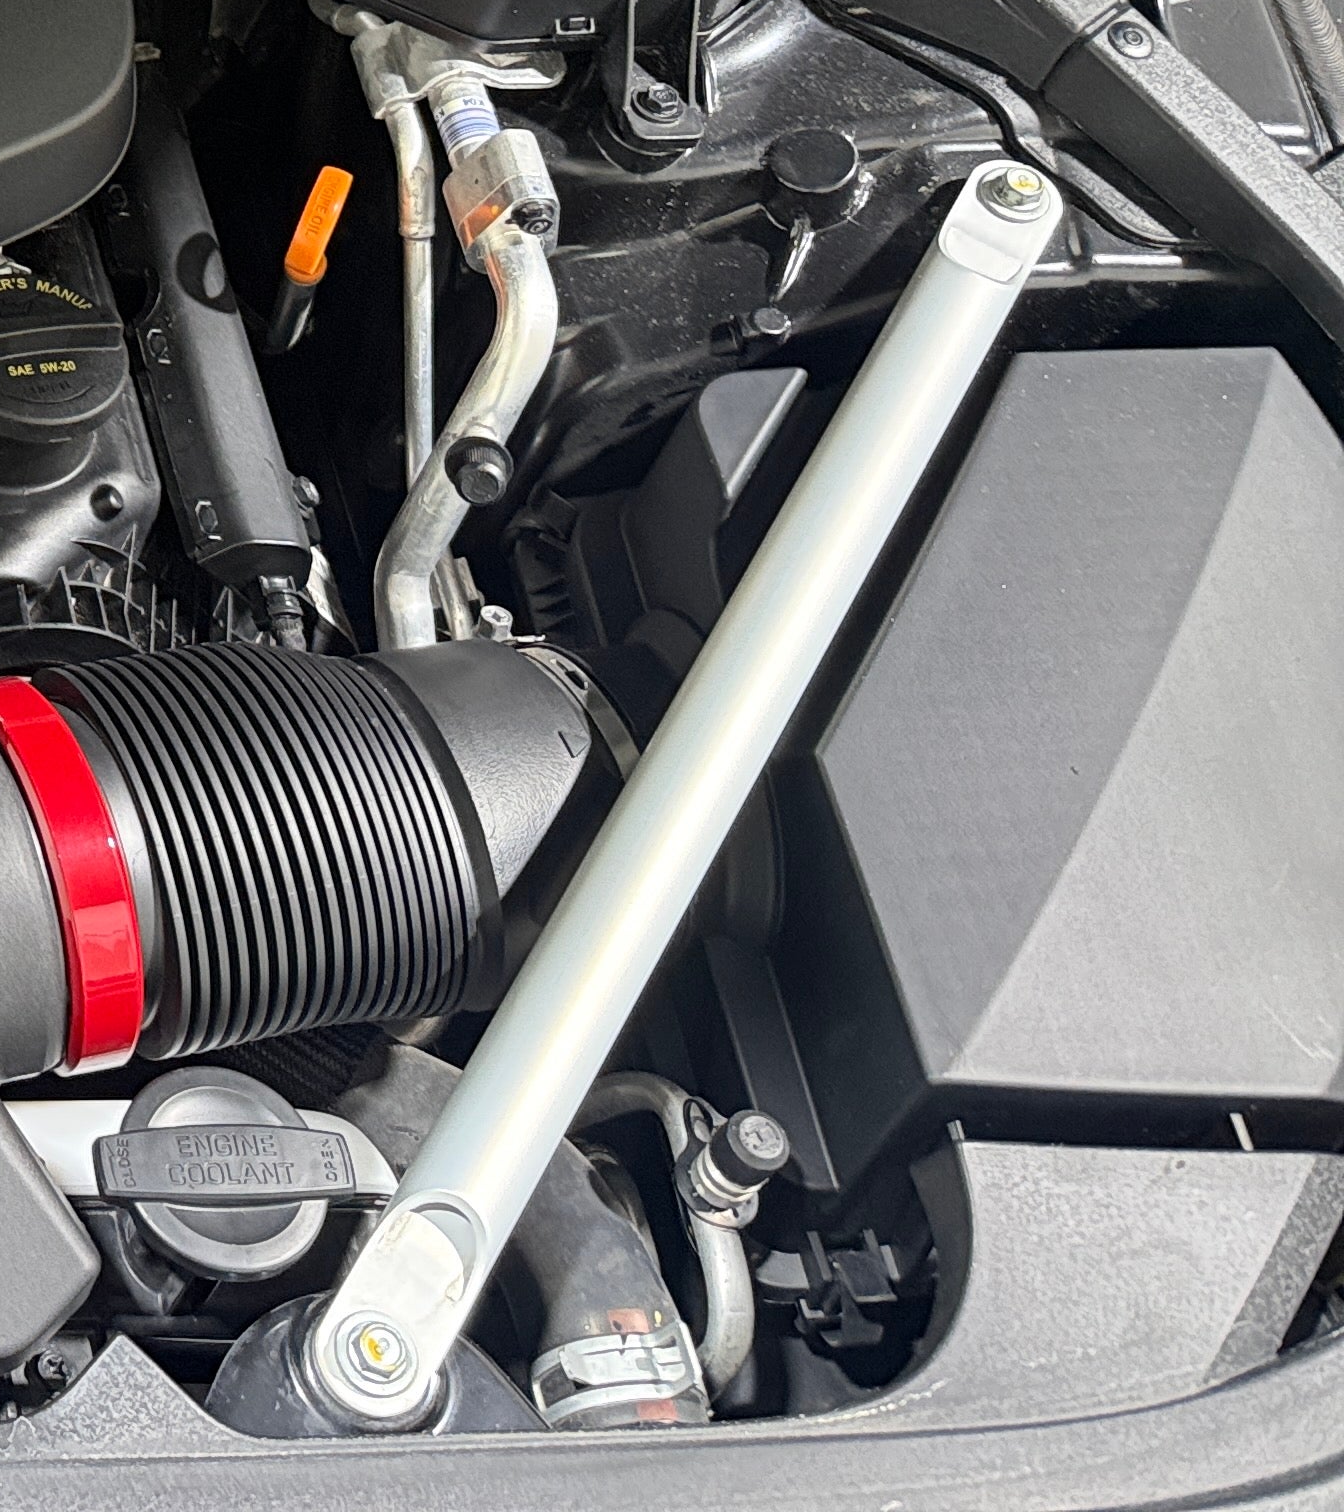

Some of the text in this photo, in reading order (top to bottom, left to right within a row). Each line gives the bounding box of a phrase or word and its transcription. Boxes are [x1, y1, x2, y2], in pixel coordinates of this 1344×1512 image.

[304, 176, 341, 240] ENGINE OIL
[8, 360, 76, 377] SAE 5W-20
[116, 1137, 136, 1188] CLOSE
[176, 1134, 278, 1158] ENGINE
[321, 1139, 338, 1182] OPEN
[168, 1161, 295, 1187] COOLANT
